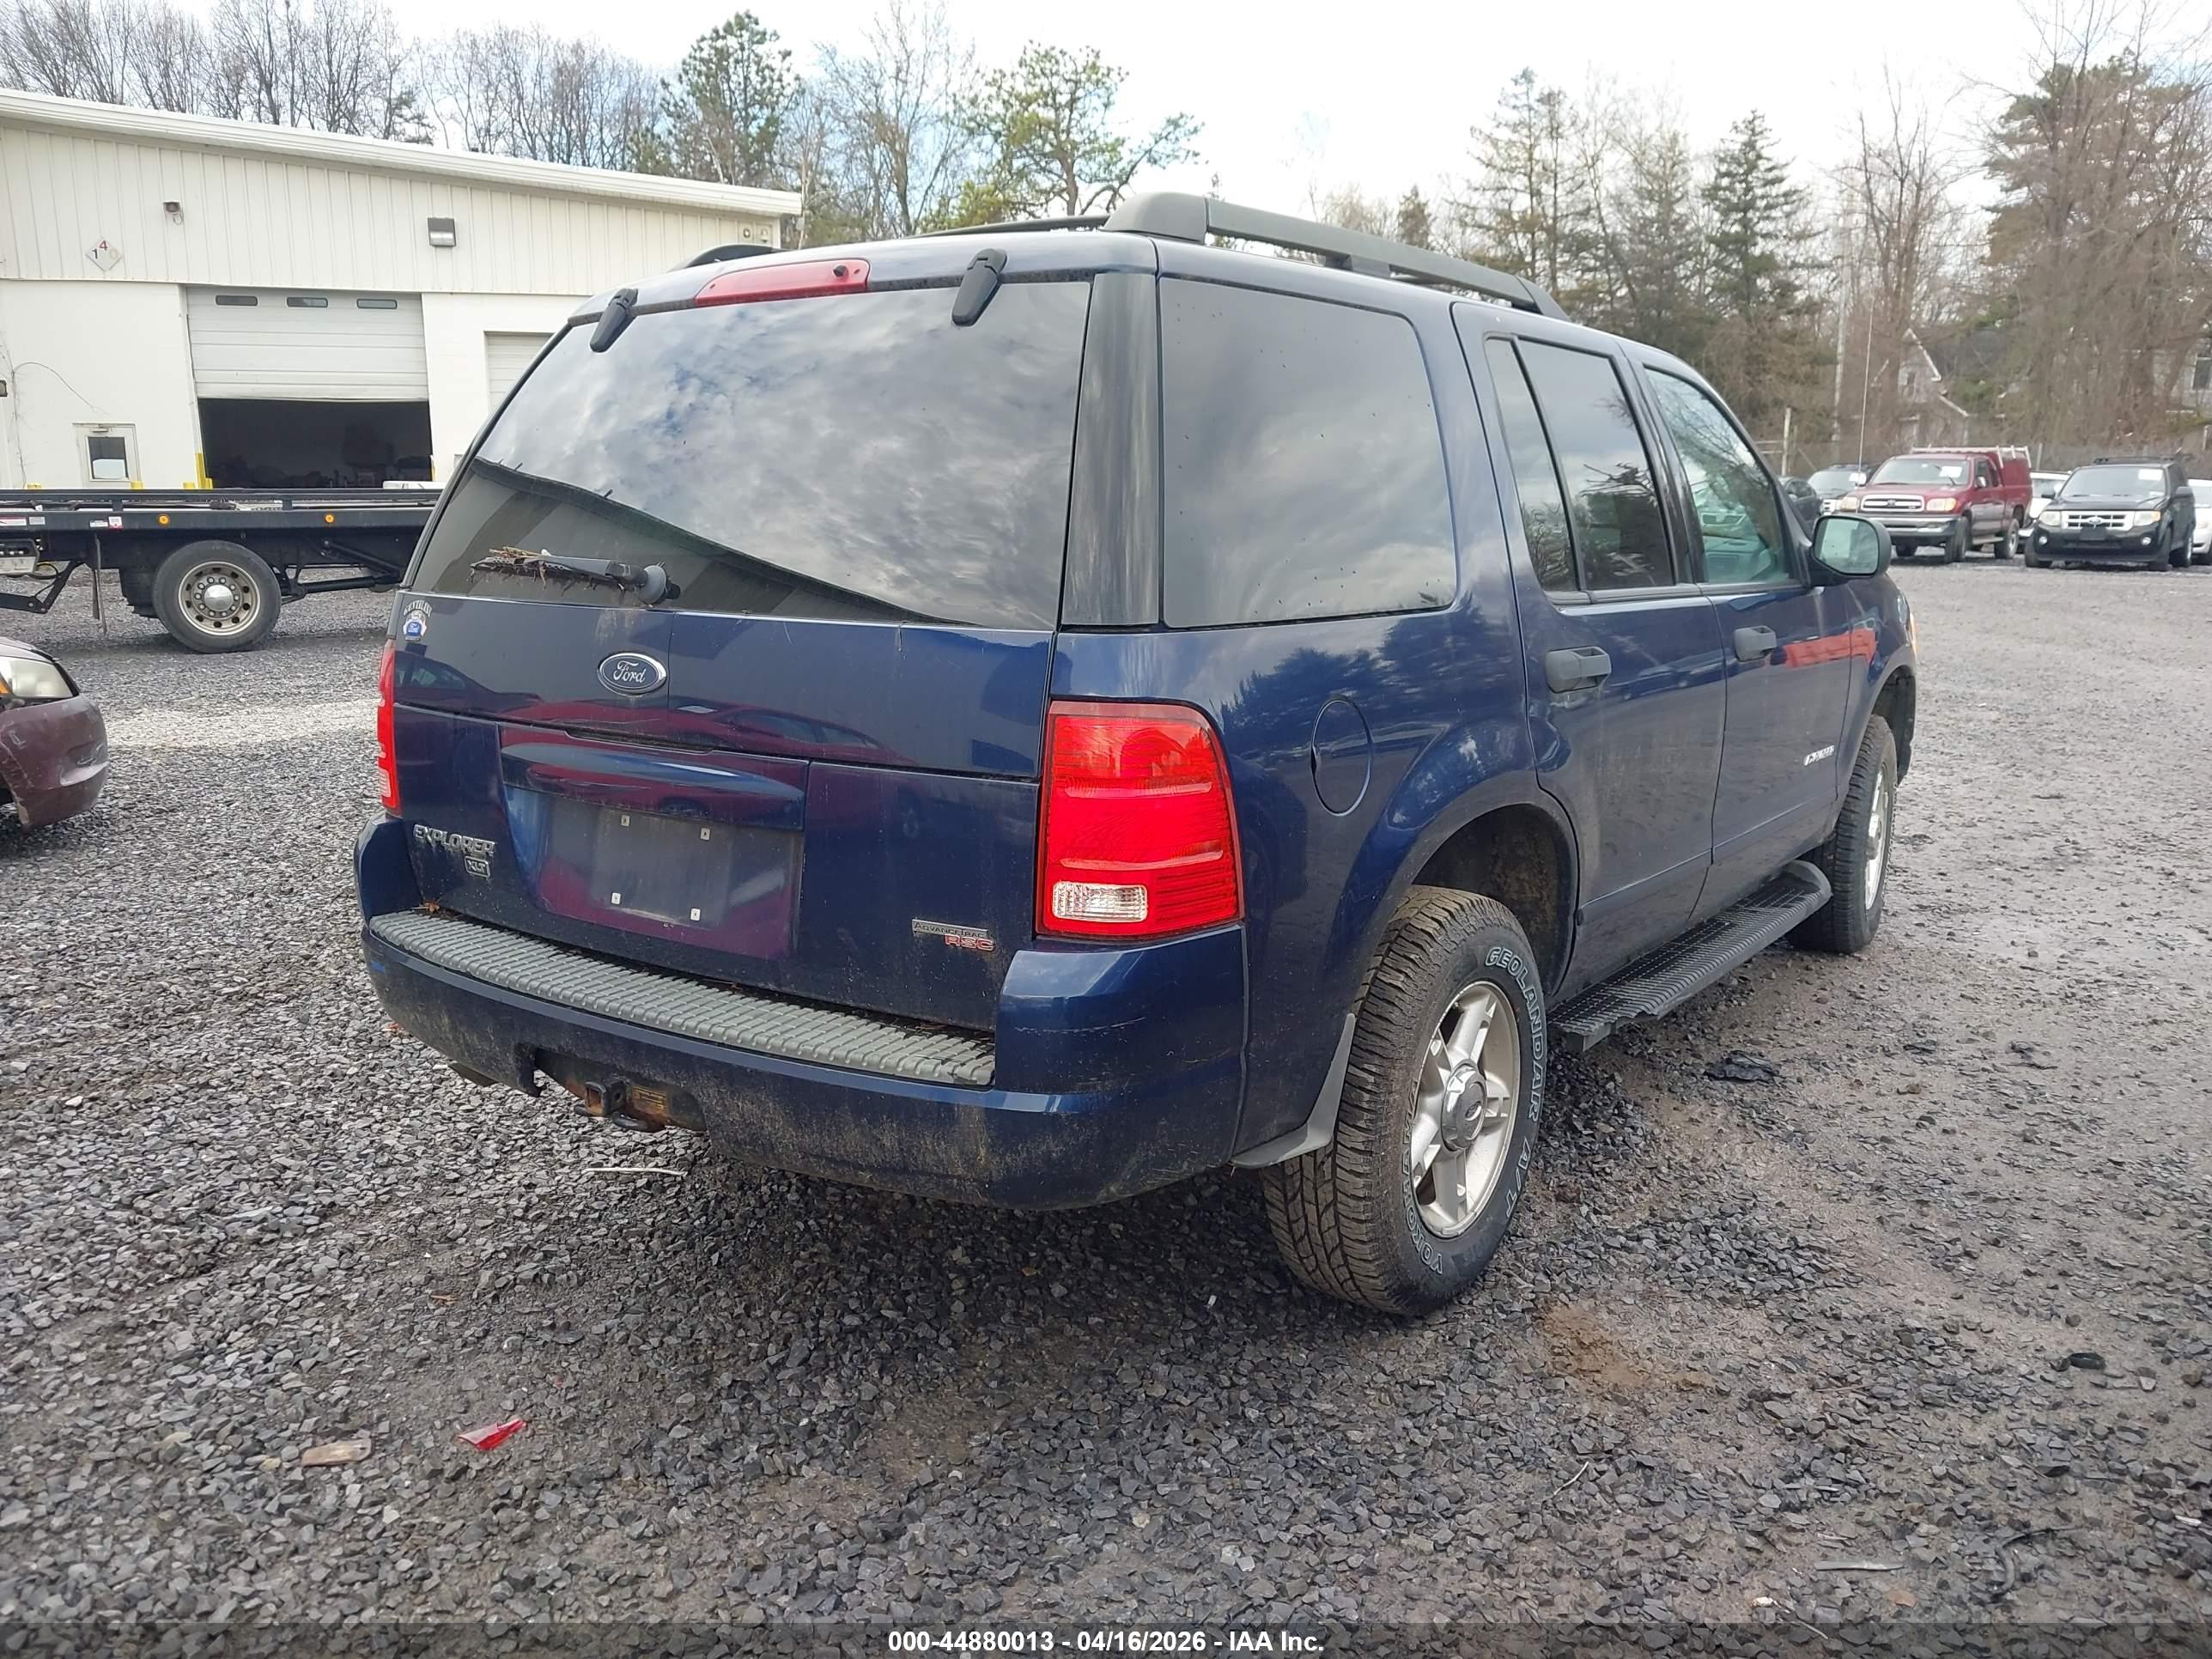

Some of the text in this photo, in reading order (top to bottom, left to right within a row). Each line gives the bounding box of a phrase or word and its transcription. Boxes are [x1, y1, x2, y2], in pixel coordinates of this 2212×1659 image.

[91, 248, 99, 259] 1
[99, 240, 108, 252] 4
[612, 659, 647, 684] Ford
[412, 823, 495, 857] EXPLORER
[466, 860, 487, 873] XLT
[944, 933, 995, 951] RSC
[1485, 946, 1544, 1219] GEOLANDAR A/T
